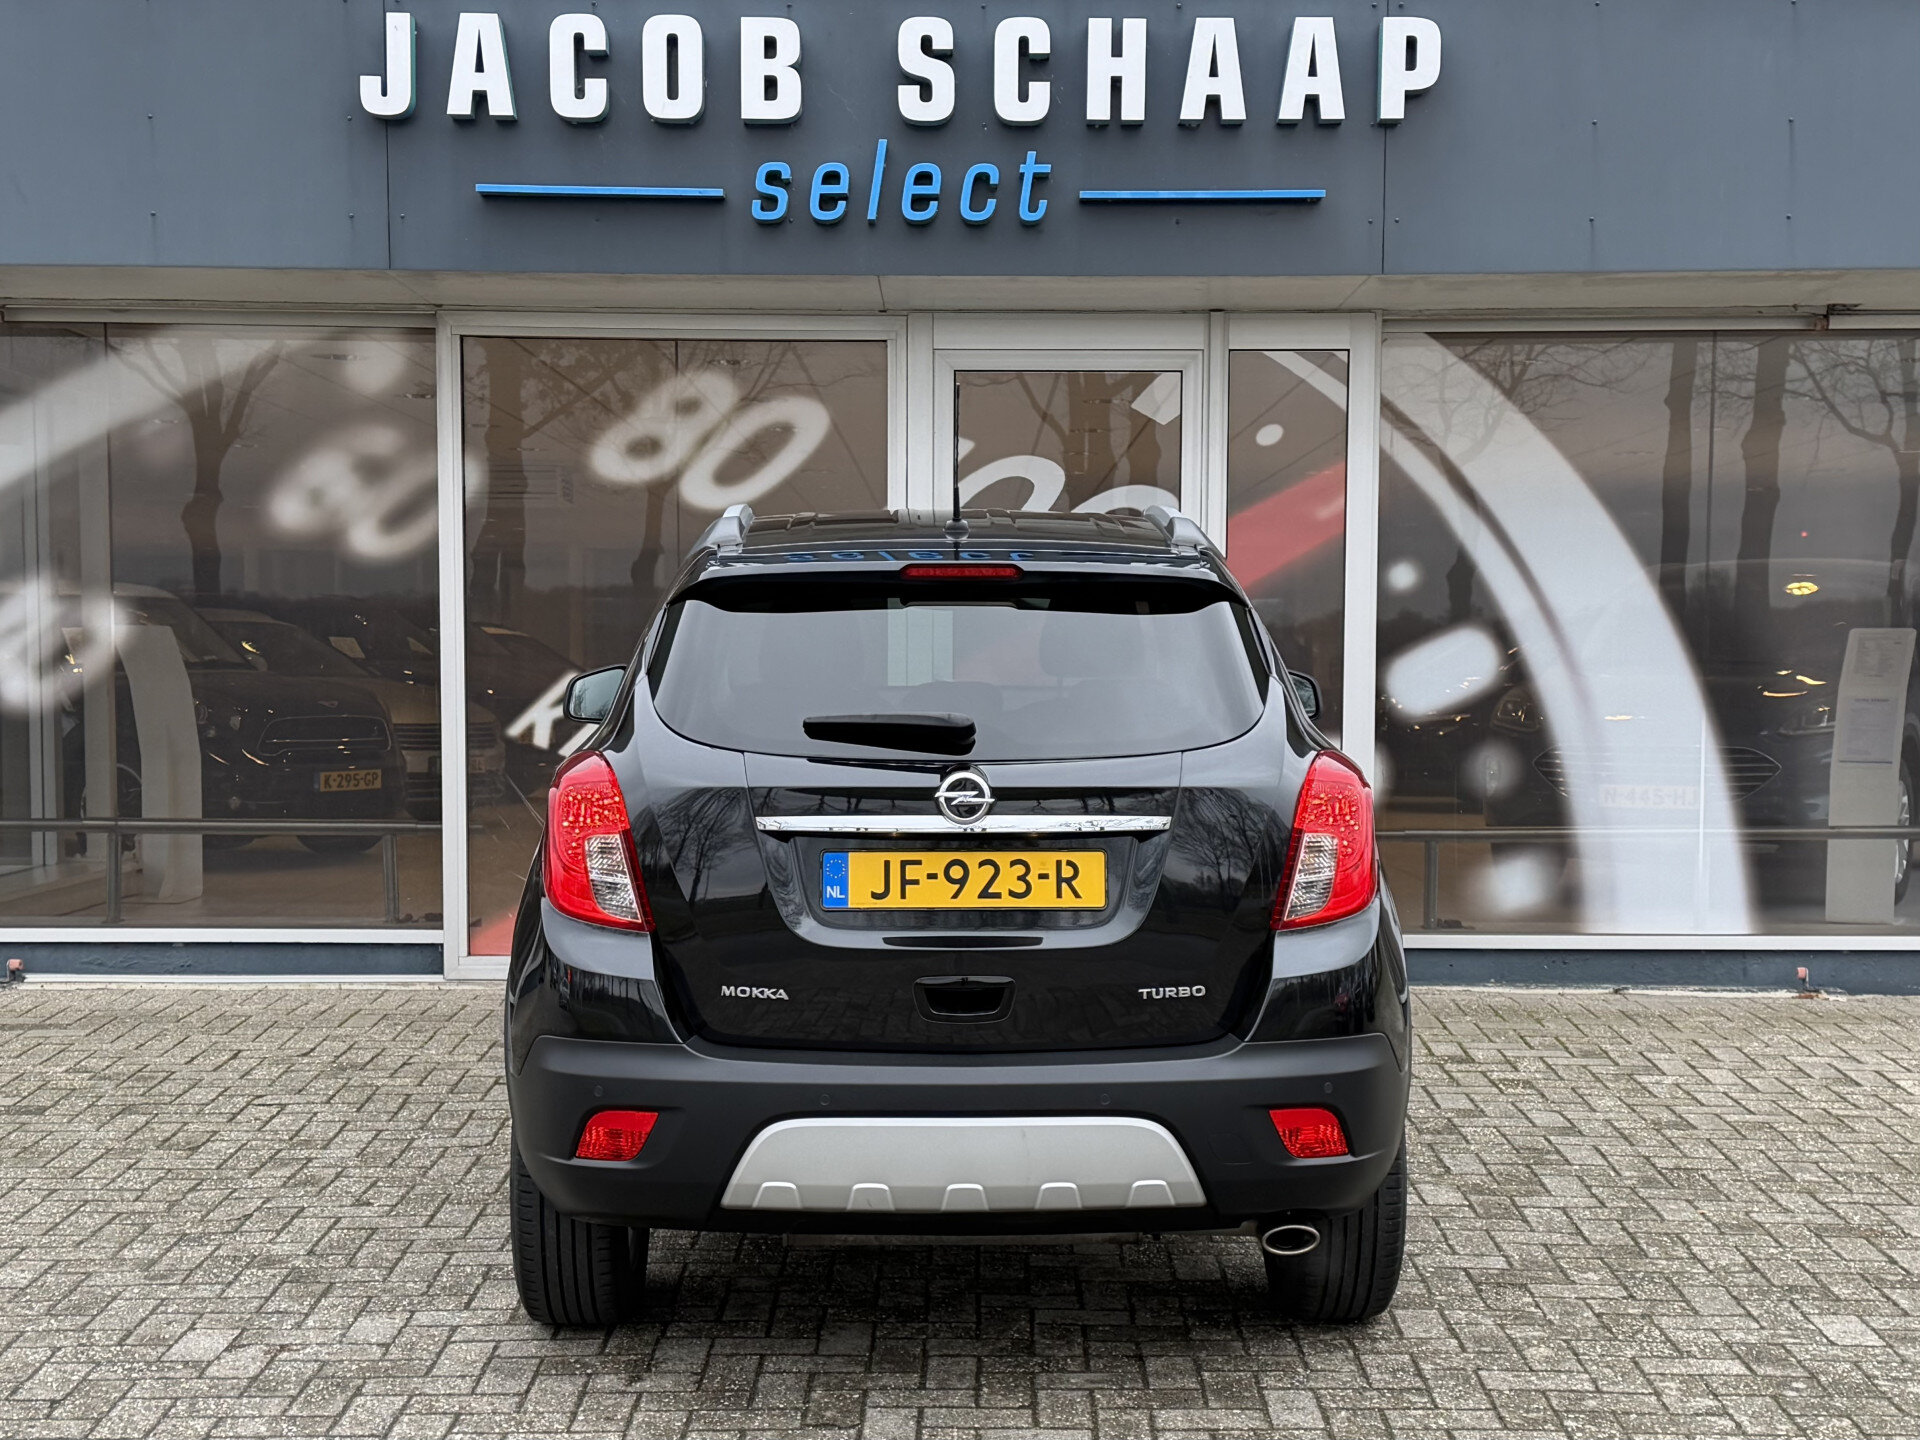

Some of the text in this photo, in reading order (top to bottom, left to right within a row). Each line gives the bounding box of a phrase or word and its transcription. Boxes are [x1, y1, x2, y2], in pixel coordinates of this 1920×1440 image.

[360, 12, 1442, 124] JACOB SCHAAP
[752, 139, 1051, 225] select
[590, 370, 829, 510] 80
[324, 772, 379, 789] K-295-GP
[826, 885, 846, 899] NL
[870, 858, 1083, 900] JF-923-R
[721, 985, 789, 1000] MOKKA
[1138, 985, 1206, 1000] TURBO
